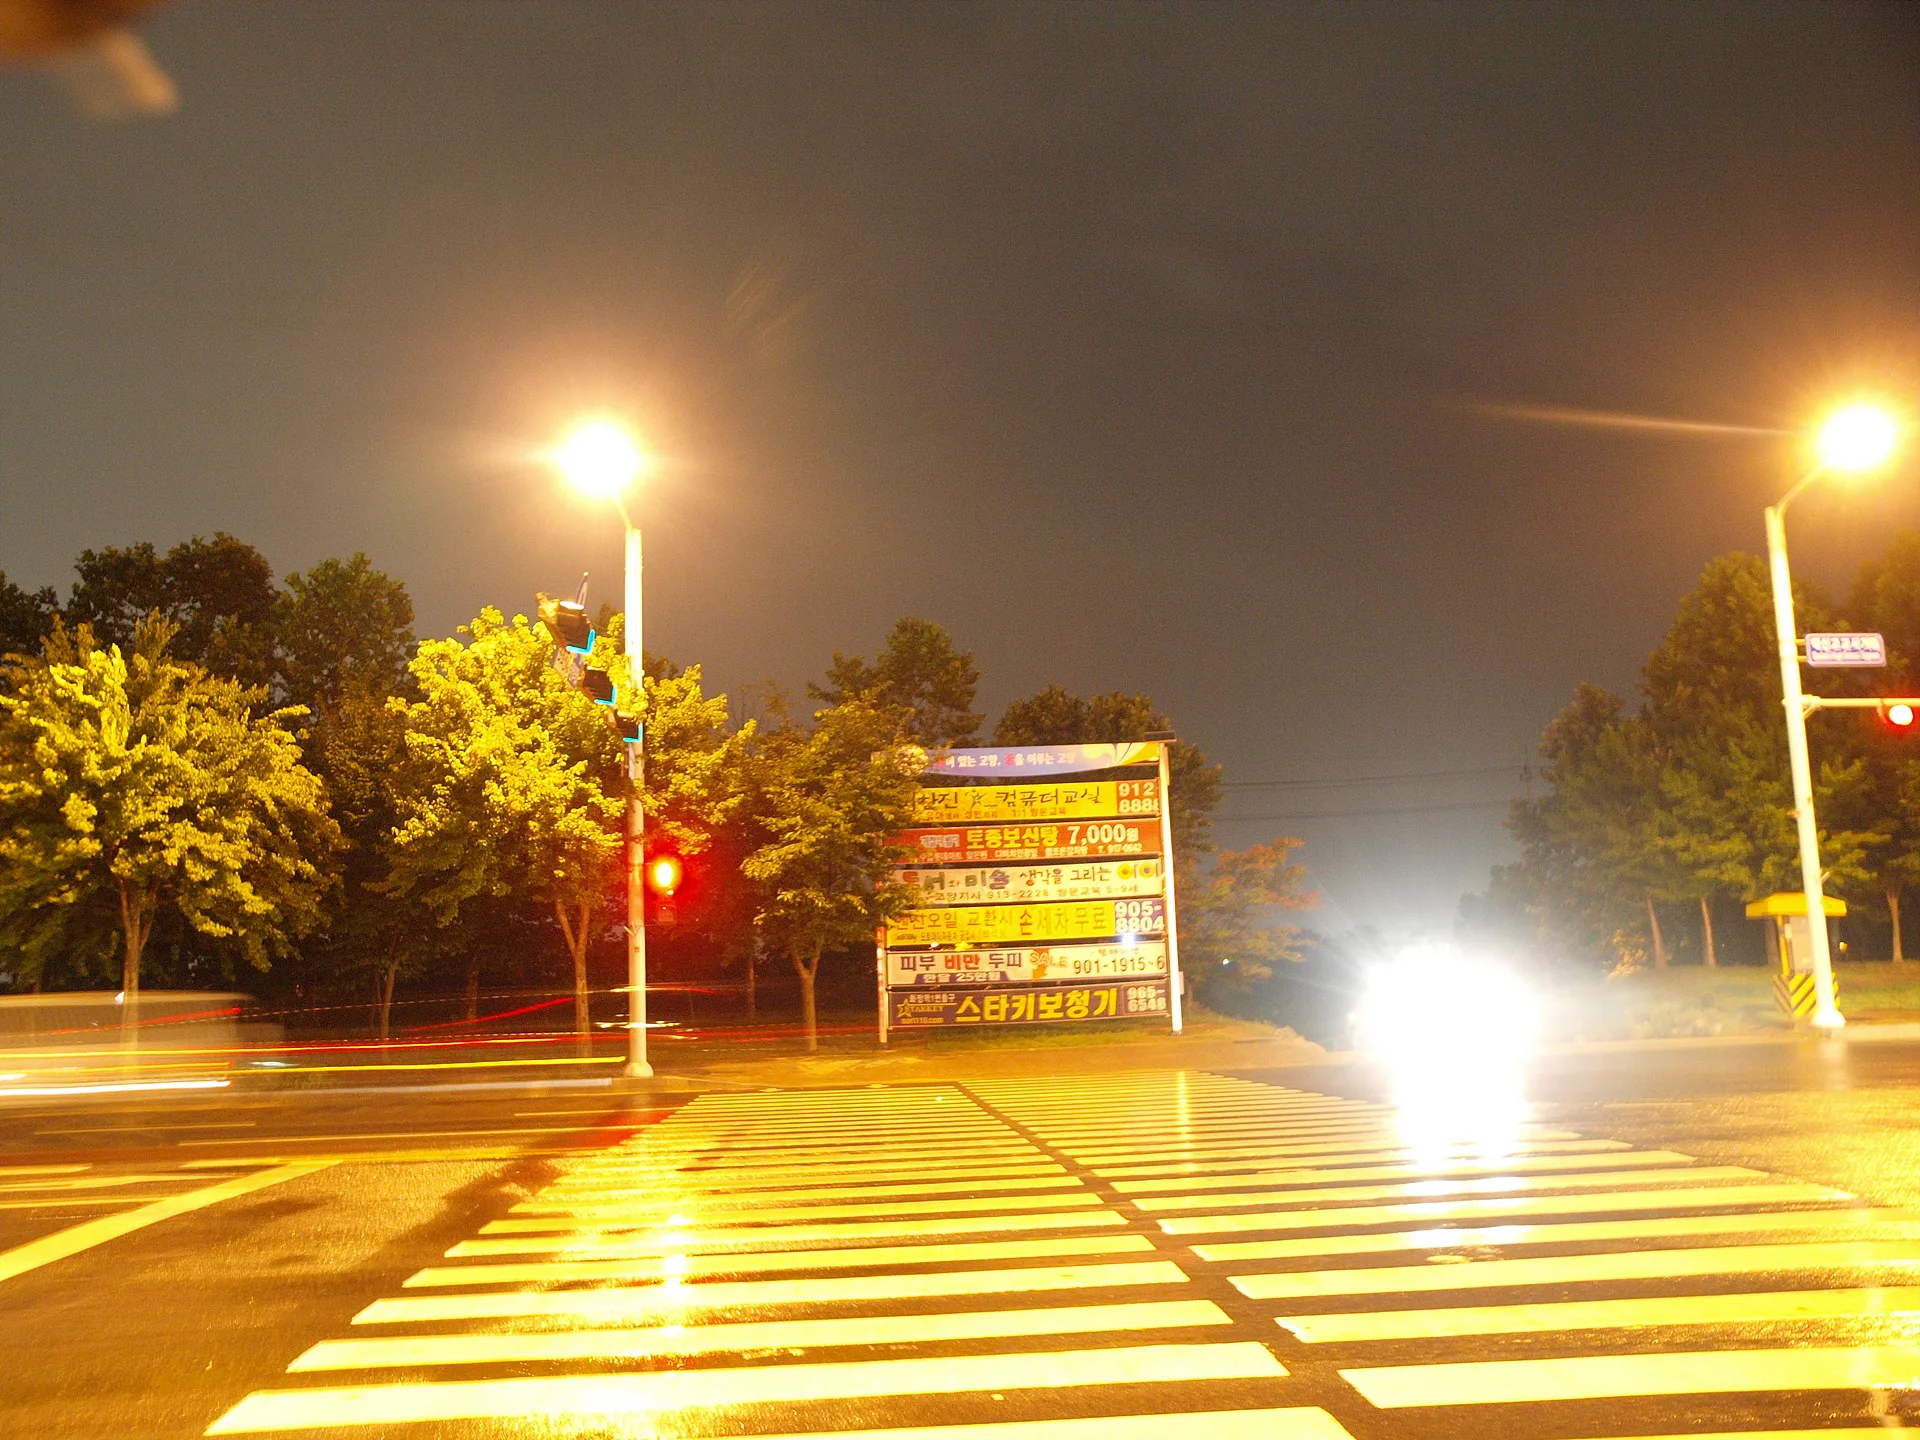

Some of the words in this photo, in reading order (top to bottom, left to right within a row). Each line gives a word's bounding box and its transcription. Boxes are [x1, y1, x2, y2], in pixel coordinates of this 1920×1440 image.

[966, 825, 1059, 849] 토종보신탕
[1067, 823, 1139, 846] 7,000원
[964, 869, 1010, 889] 미술
[1019, 868, 1063, 886] 생각을
[1070, 866, 1113, 882] 그리는
[967, 909, 1013, 927] 교환시
[900, 956, 936, 972] 피부
[944, 954, 980, 971] 비만
[989, 952, 1022, 969] 두피
[1029, 951, 1068, 968] SALE
[955, 987, 1118, 1022] 스타키보청기
